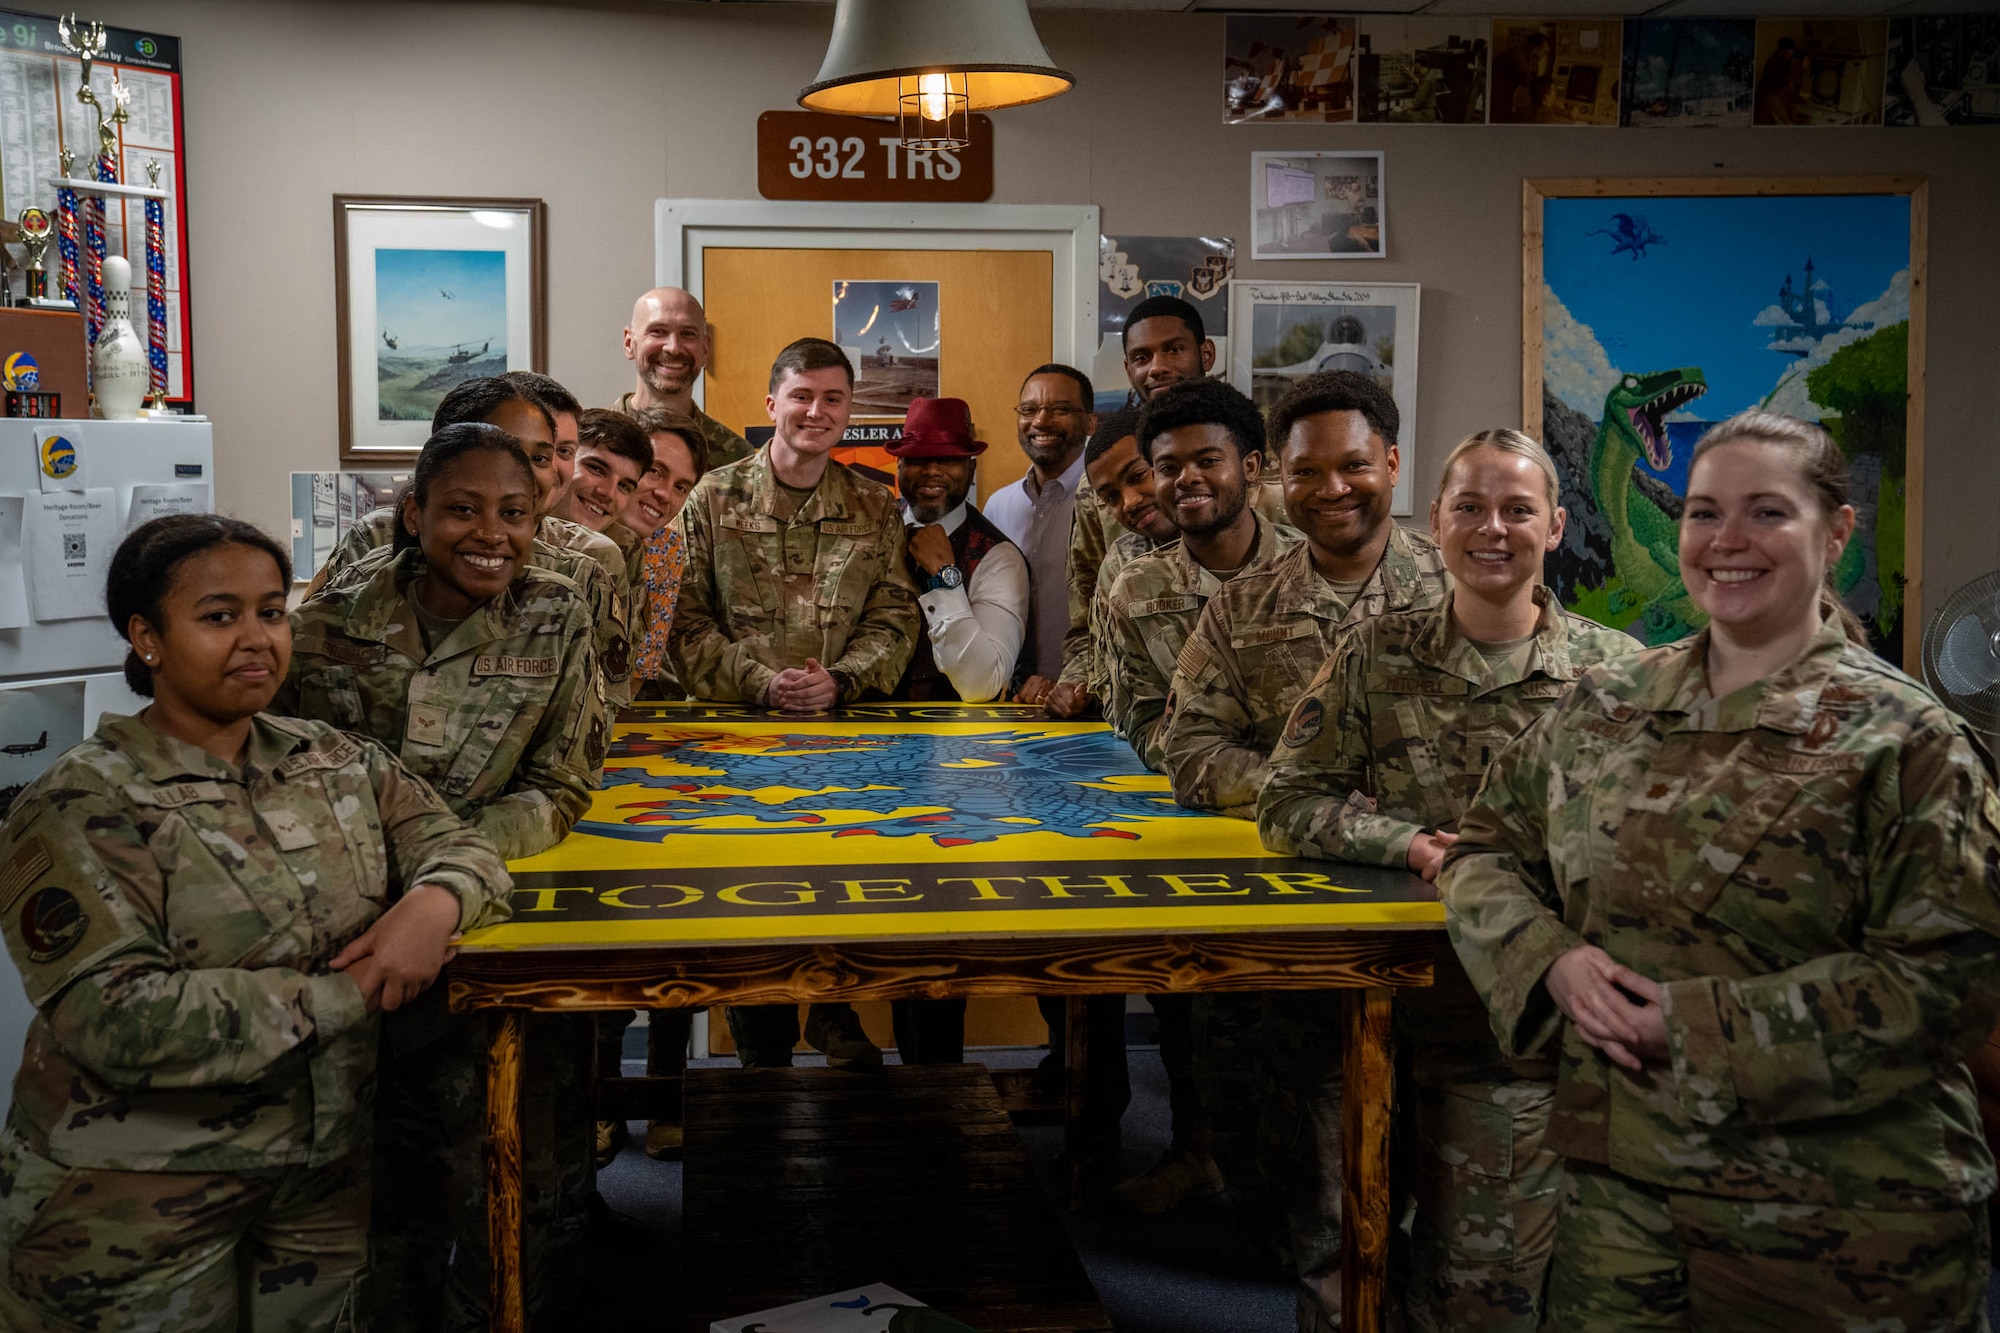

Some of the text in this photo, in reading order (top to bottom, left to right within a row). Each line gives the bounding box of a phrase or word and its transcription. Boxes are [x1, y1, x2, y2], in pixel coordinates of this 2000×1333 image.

[12, 23, 37, 47] 9i
[110, 51, 122, 62] by
[788, 135, 962, 181] 332 TRS
[842, 427, 904, 440] ESLER A
[43, 502, 102, 512] Heritage Room/Beer
[140, 497, 162, 505] Heritage
[152, 506, 180, 514] Donations
[58, 513, 88, 521] Donations
[735, 519, 761, 531] WEEKS
[836, 524, 849, 533] AIR
[850, 523, 873, 533] FORCE
[496, 657, 514, 672] AIR
[516, 658, 554, 673] FORCE
[1385, 677, 1445, 694] MITCHELL
[513, 872, 1373, 911] TOGETHER
